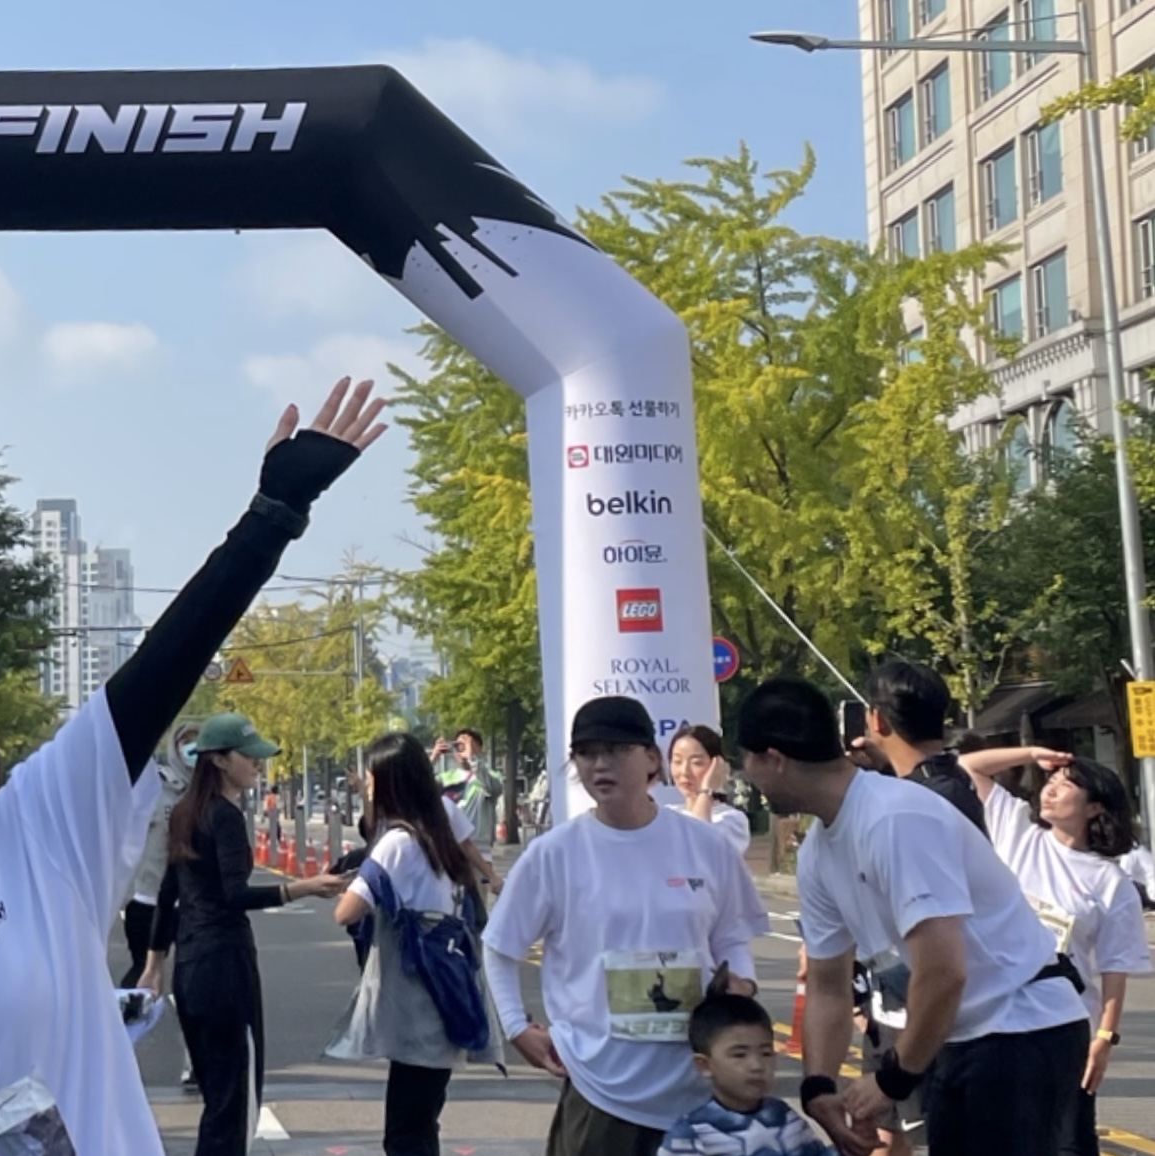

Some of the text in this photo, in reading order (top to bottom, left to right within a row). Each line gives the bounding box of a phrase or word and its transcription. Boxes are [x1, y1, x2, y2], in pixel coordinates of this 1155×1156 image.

[629, 401, 681, 418] 선물하기
[594, 443, 684, 464] 대원미디어
[587, 490, 673, 517] belkin
[621, 603, 659, 619] LEGO
[611, 657, 675, 675] ROYAL
[593, 678, 692, 696] SELANGOR
